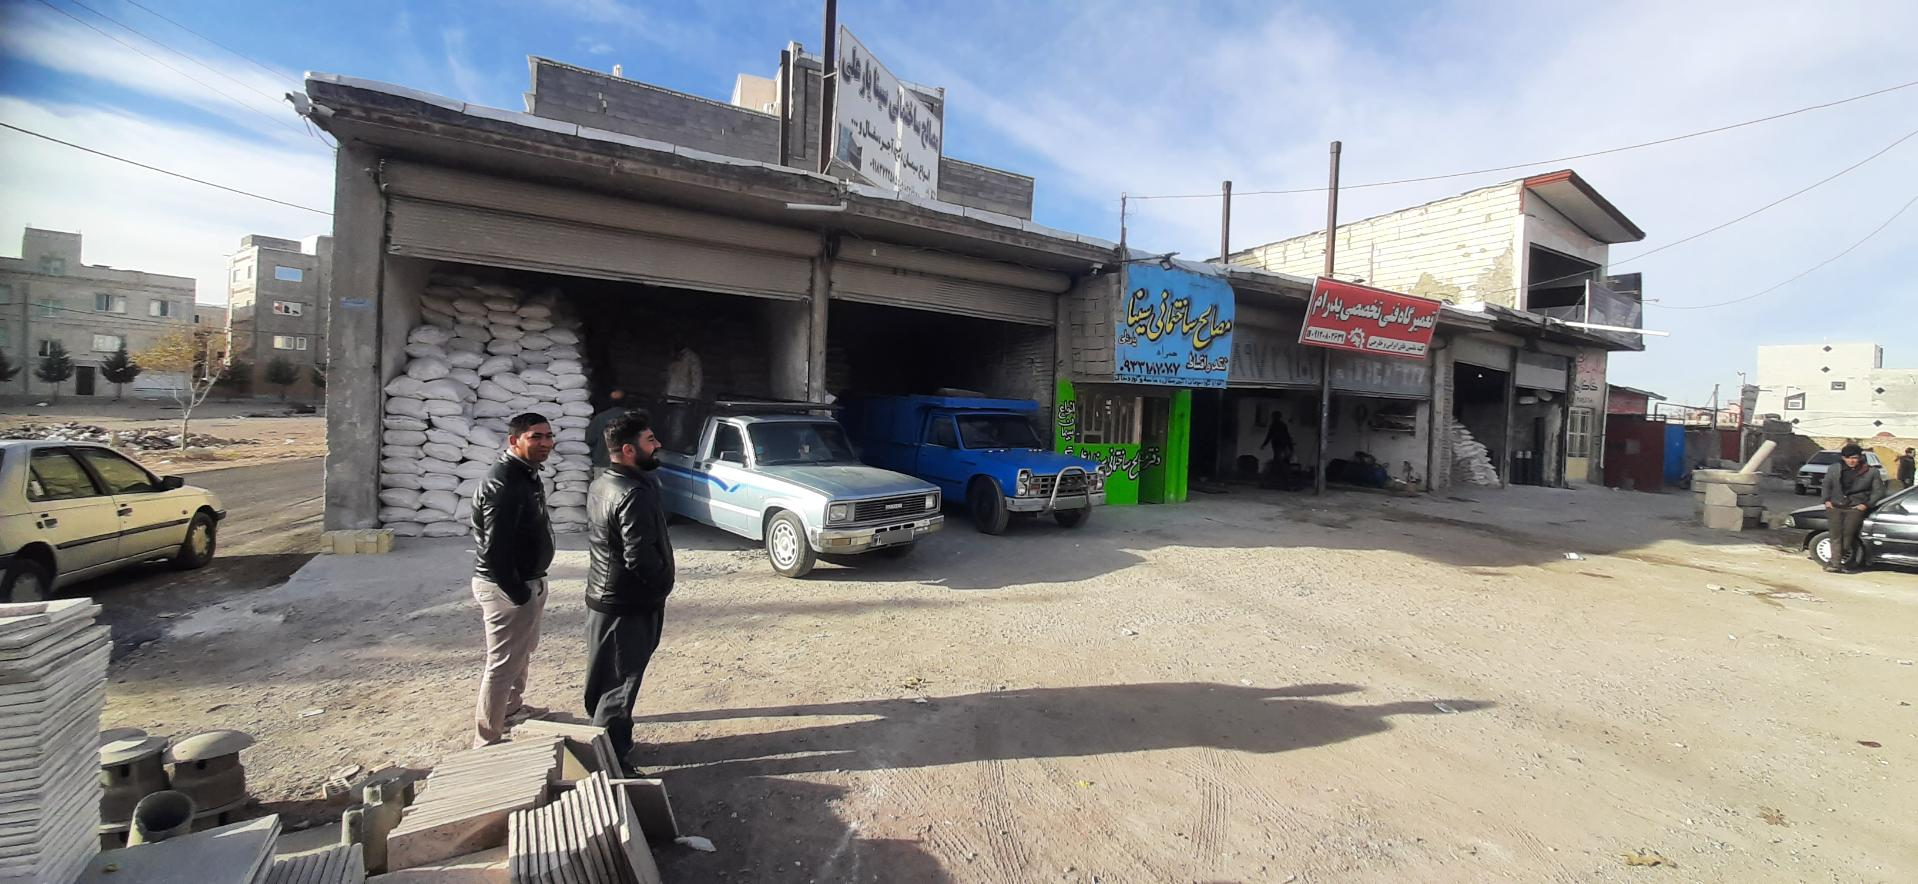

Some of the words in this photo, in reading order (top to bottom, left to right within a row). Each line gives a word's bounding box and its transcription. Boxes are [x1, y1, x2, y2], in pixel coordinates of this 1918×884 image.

[873, 66, 889, 110] سینا
[1126, 287, 1155, 336] سینا
[1146, 289, 1198, 342] ساختمانی
[1311, 289, 1343, 320] پدرام
[1340, 299, 1384, 321] تخصصی
[1378, 302, 1400, 328] فنی
[1192, 304, 1232, 351] مصالح
[1156, 344, 1178, 359] همراه
[1211, 356, 1229, 371] نقد
[1058, 400, 1076, 420] انواع
